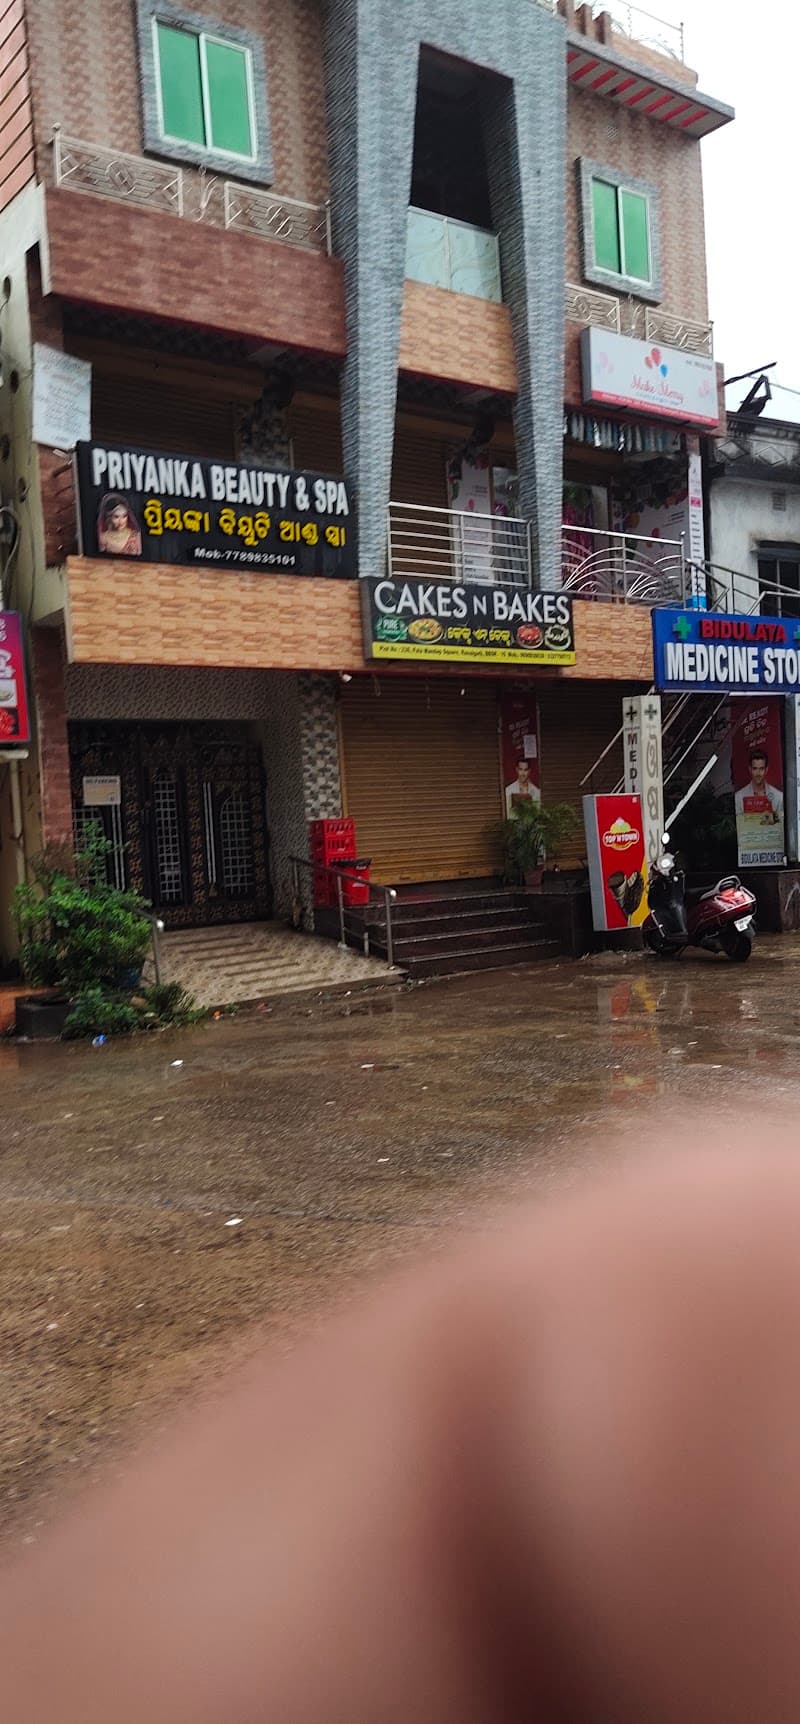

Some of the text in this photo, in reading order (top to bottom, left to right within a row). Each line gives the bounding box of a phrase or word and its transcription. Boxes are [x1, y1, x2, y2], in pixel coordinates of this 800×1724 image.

[631, 374, 656, 394] Make
[91, 448, 349, 516] PRIYANKA BEAUTY & SPA
[374, 580, 571, 625] CAKES N BAKES
[700, 619, 787, 642] BIDULATA
[665, 642, 759, 683] MEDICINE
